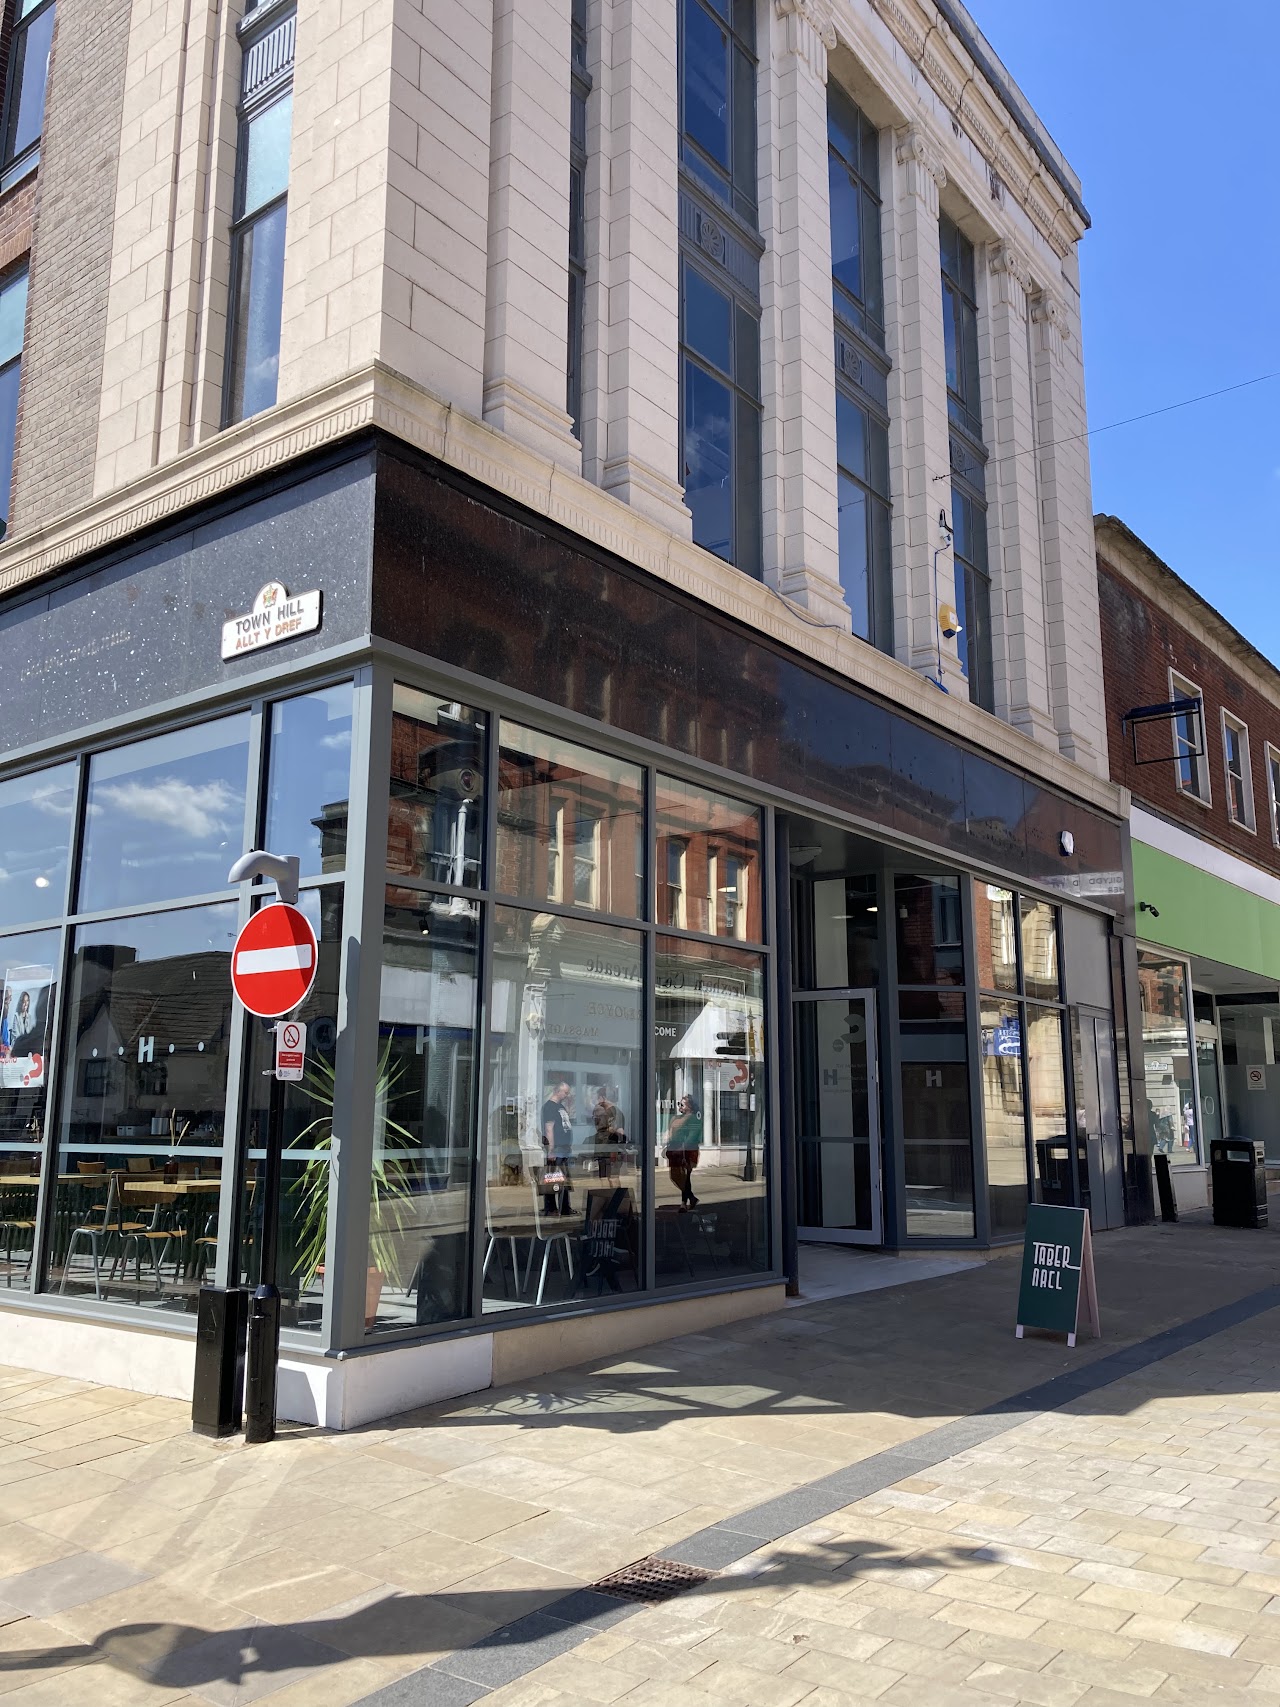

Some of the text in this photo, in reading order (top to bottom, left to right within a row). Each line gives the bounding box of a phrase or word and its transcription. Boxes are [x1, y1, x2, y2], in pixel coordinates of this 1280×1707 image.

[235, 600, 305, 635] TOWN HILL
[235, 617, 303, 650] ALLT Y DREF
[137, 1035, 155, 1063] H
[823, 1069, 838, 1086] H
[925, 1070, 943, 1087] H
[1032, 1241, 1081, 1270] TABER
[1031, 1268, 1062, 1290] NACL
